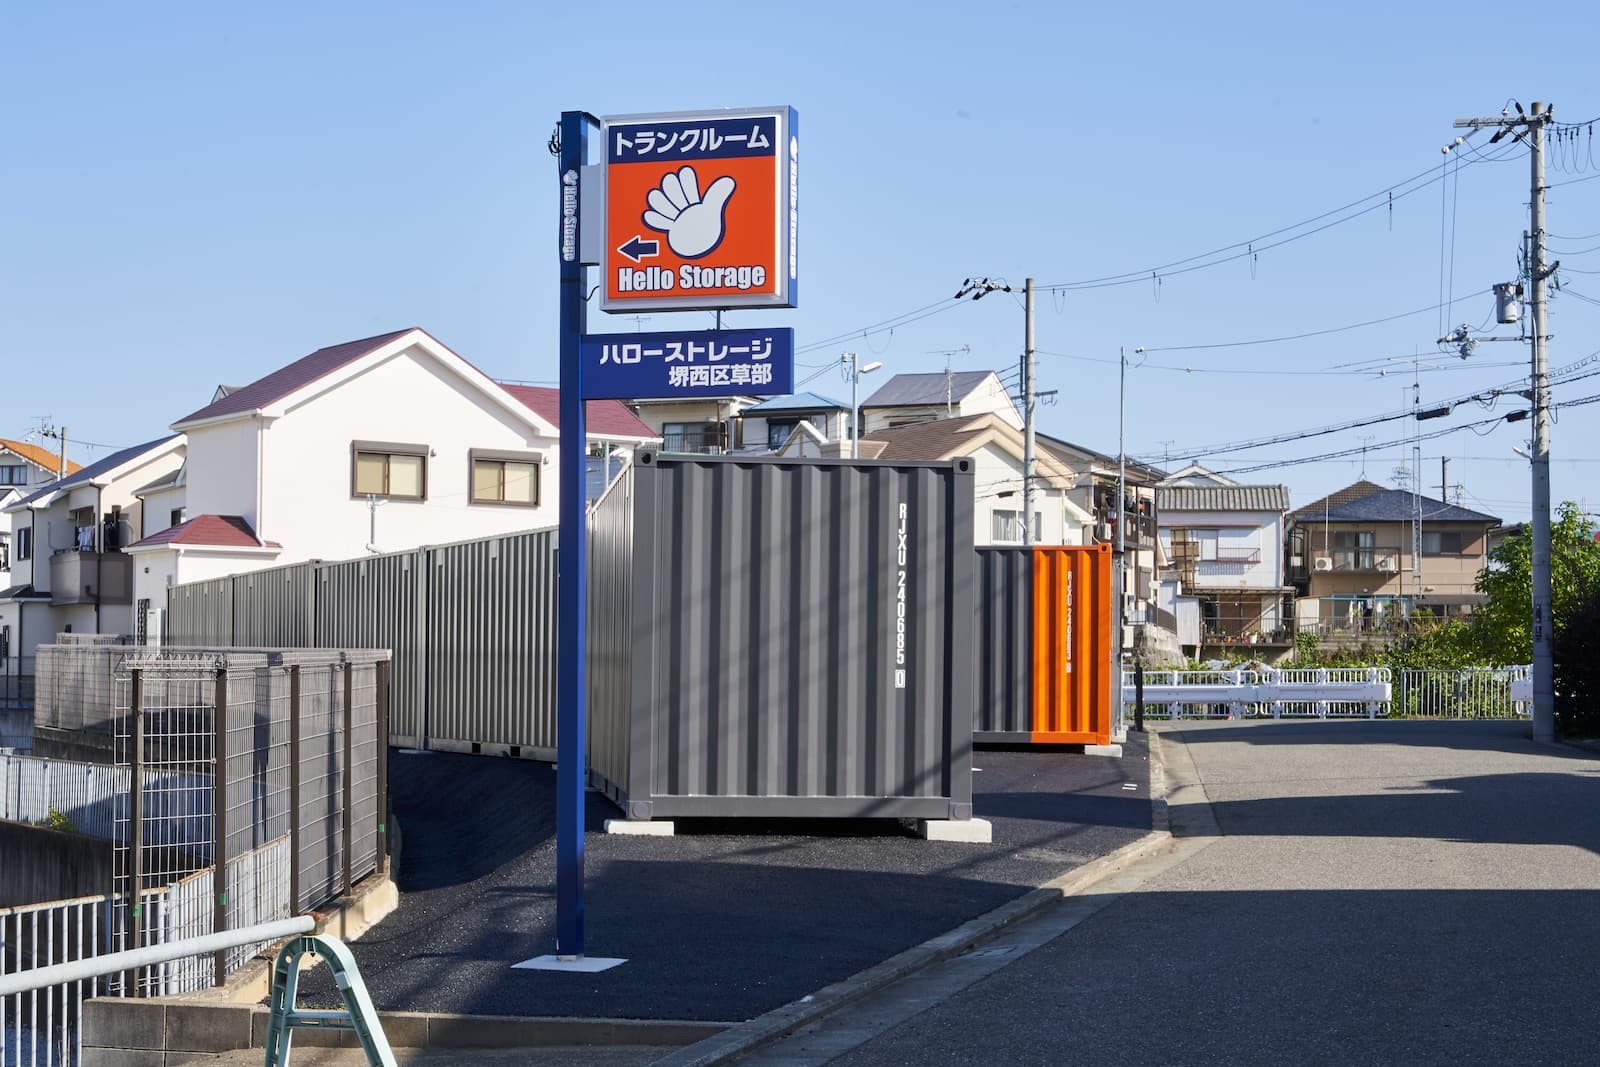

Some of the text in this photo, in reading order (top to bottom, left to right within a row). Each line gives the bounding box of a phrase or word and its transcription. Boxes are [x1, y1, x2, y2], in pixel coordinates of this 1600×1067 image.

[616, 126, 770, 157] トランクルーム
[618, 264, 767, 293] Hello Storage
[599, 337, 773, 365] ハローストレージ
[668, 363, 773, 388] 堺西区草部
[897, 503, 907, 566] RJXU
[896, 570, 906, 665] 240685
